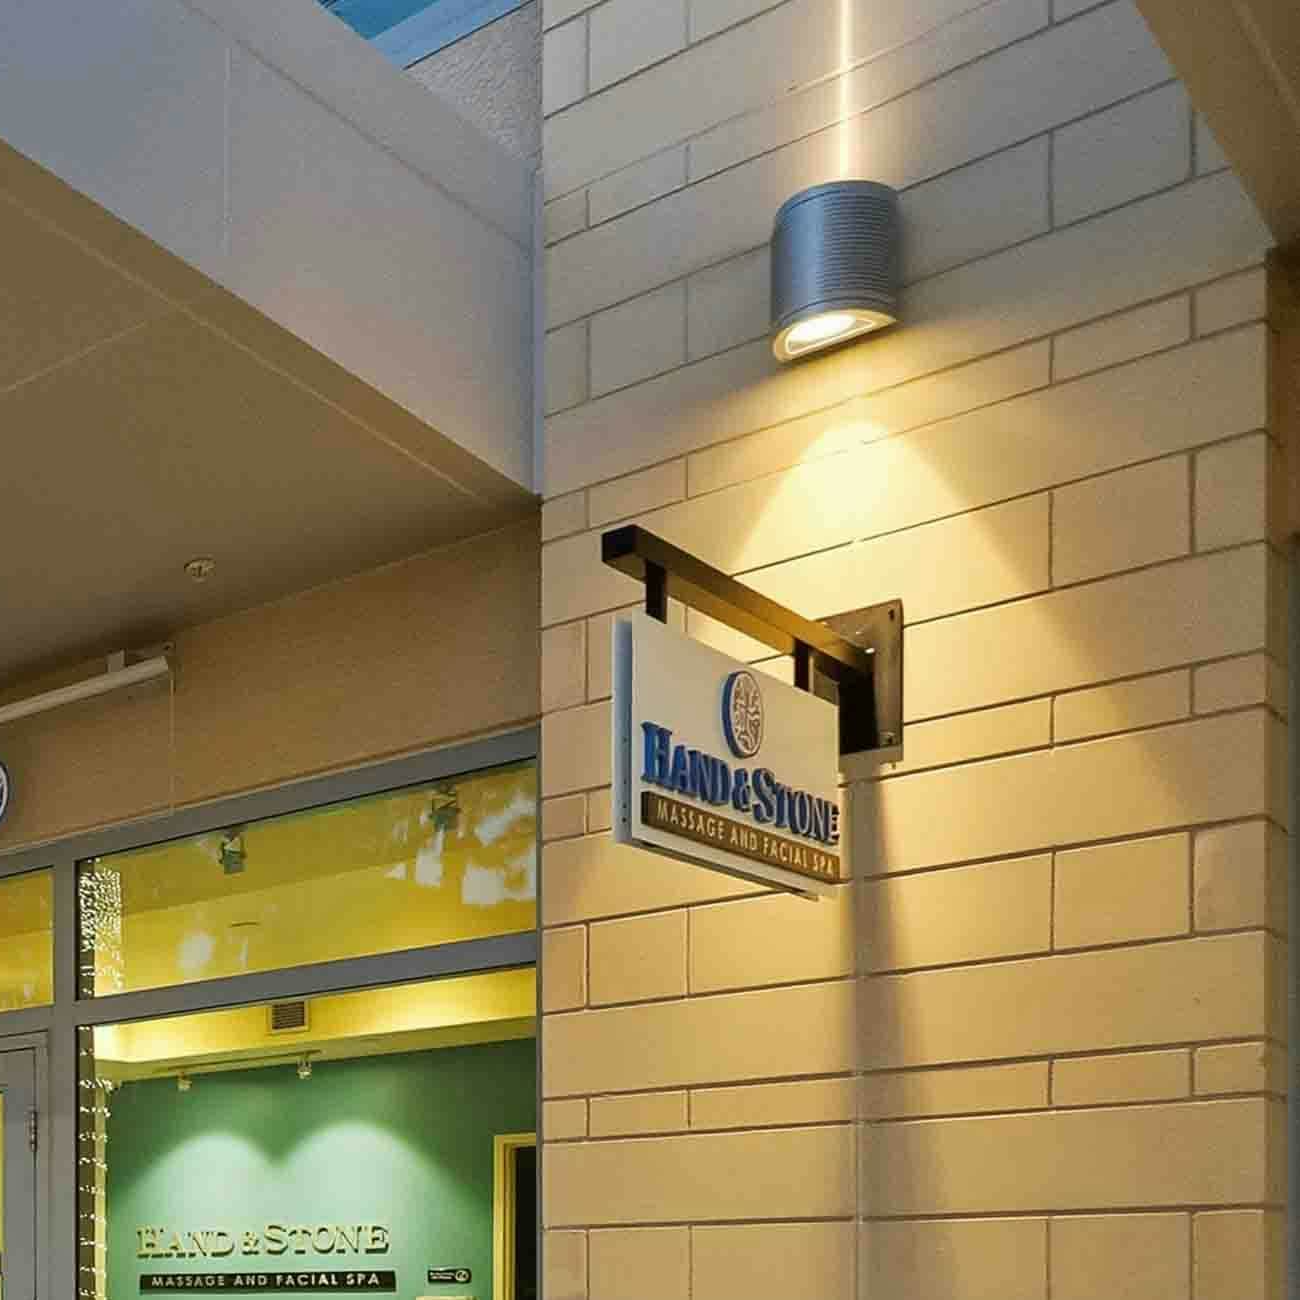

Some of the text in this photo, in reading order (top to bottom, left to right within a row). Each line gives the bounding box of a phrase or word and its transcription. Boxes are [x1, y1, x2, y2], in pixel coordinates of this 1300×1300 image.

[640, 721, 840, 846] HAND & STONE
[656, 799, 835, 875] MASSAGE AND FACIAL SPA
[136, 1224, 391, 1258] HAND & STONE
[151, 1271, 380, 1288] MASSAGE AND FACIAL SPA
